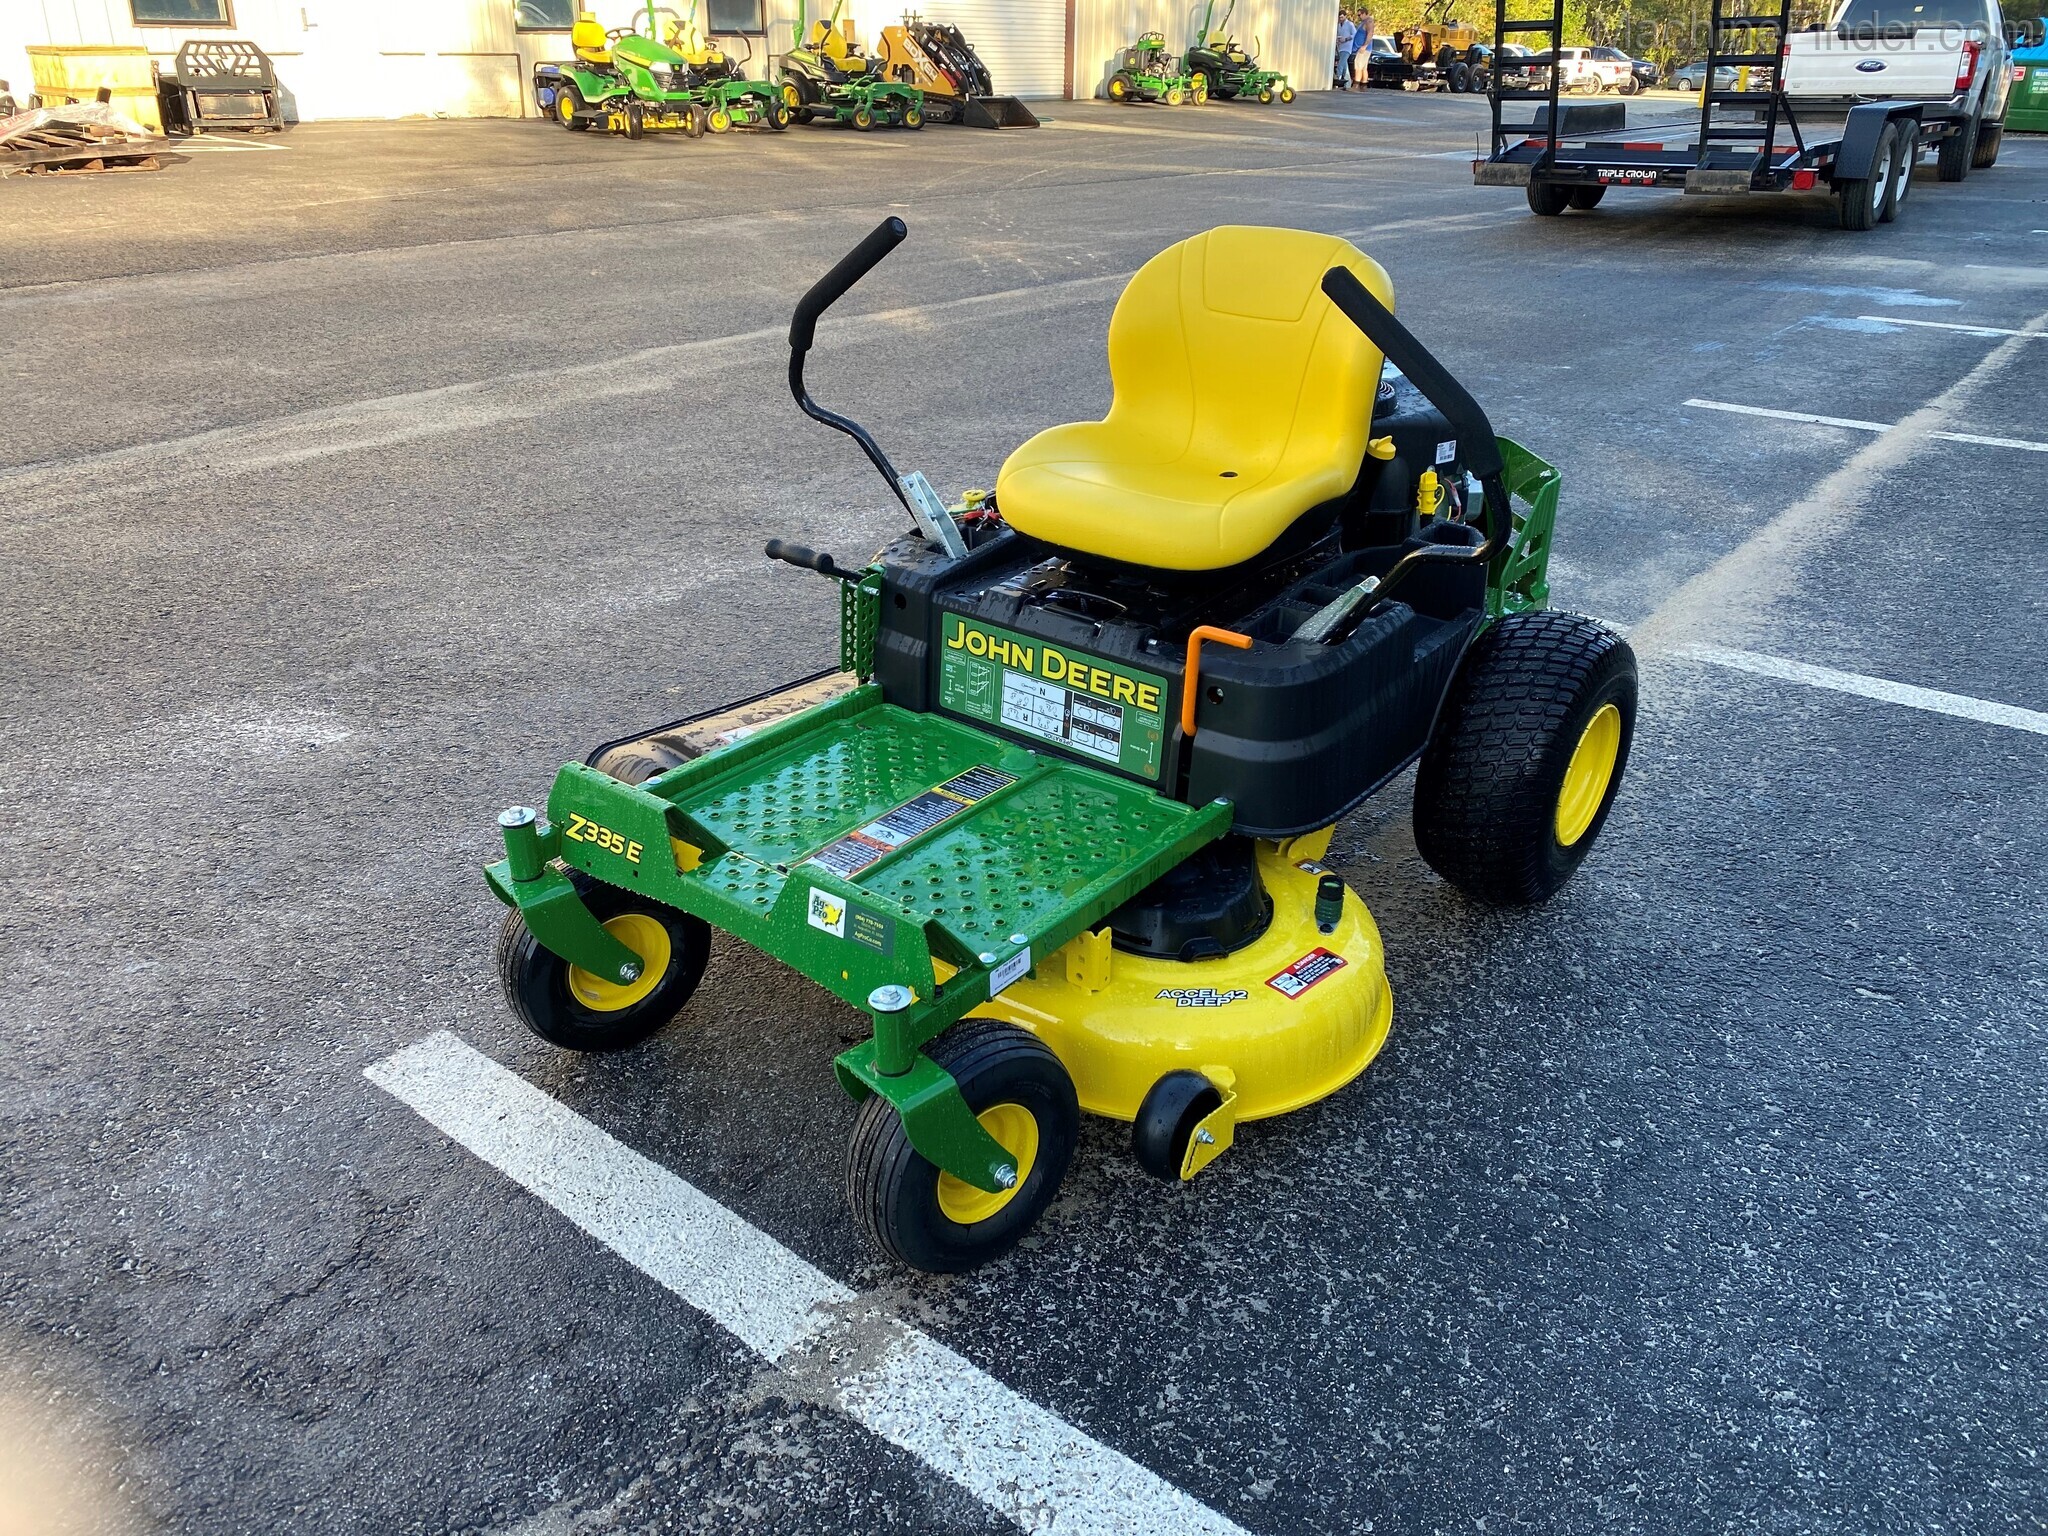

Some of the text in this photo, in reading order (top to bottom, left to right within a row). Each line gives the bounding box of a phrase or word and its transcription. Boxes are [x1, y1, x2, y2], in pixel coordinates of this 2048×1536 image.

[903, 38, 938, 80] BOXER
[1597, 168, 1657, 179] TRIPLE CROWN
[947, 620, 1161, 713] JOHN DEERE
[1154, 988, 1249, 1000] ACCEL 42
[1176, 997, 1231, 1007] DEEP
